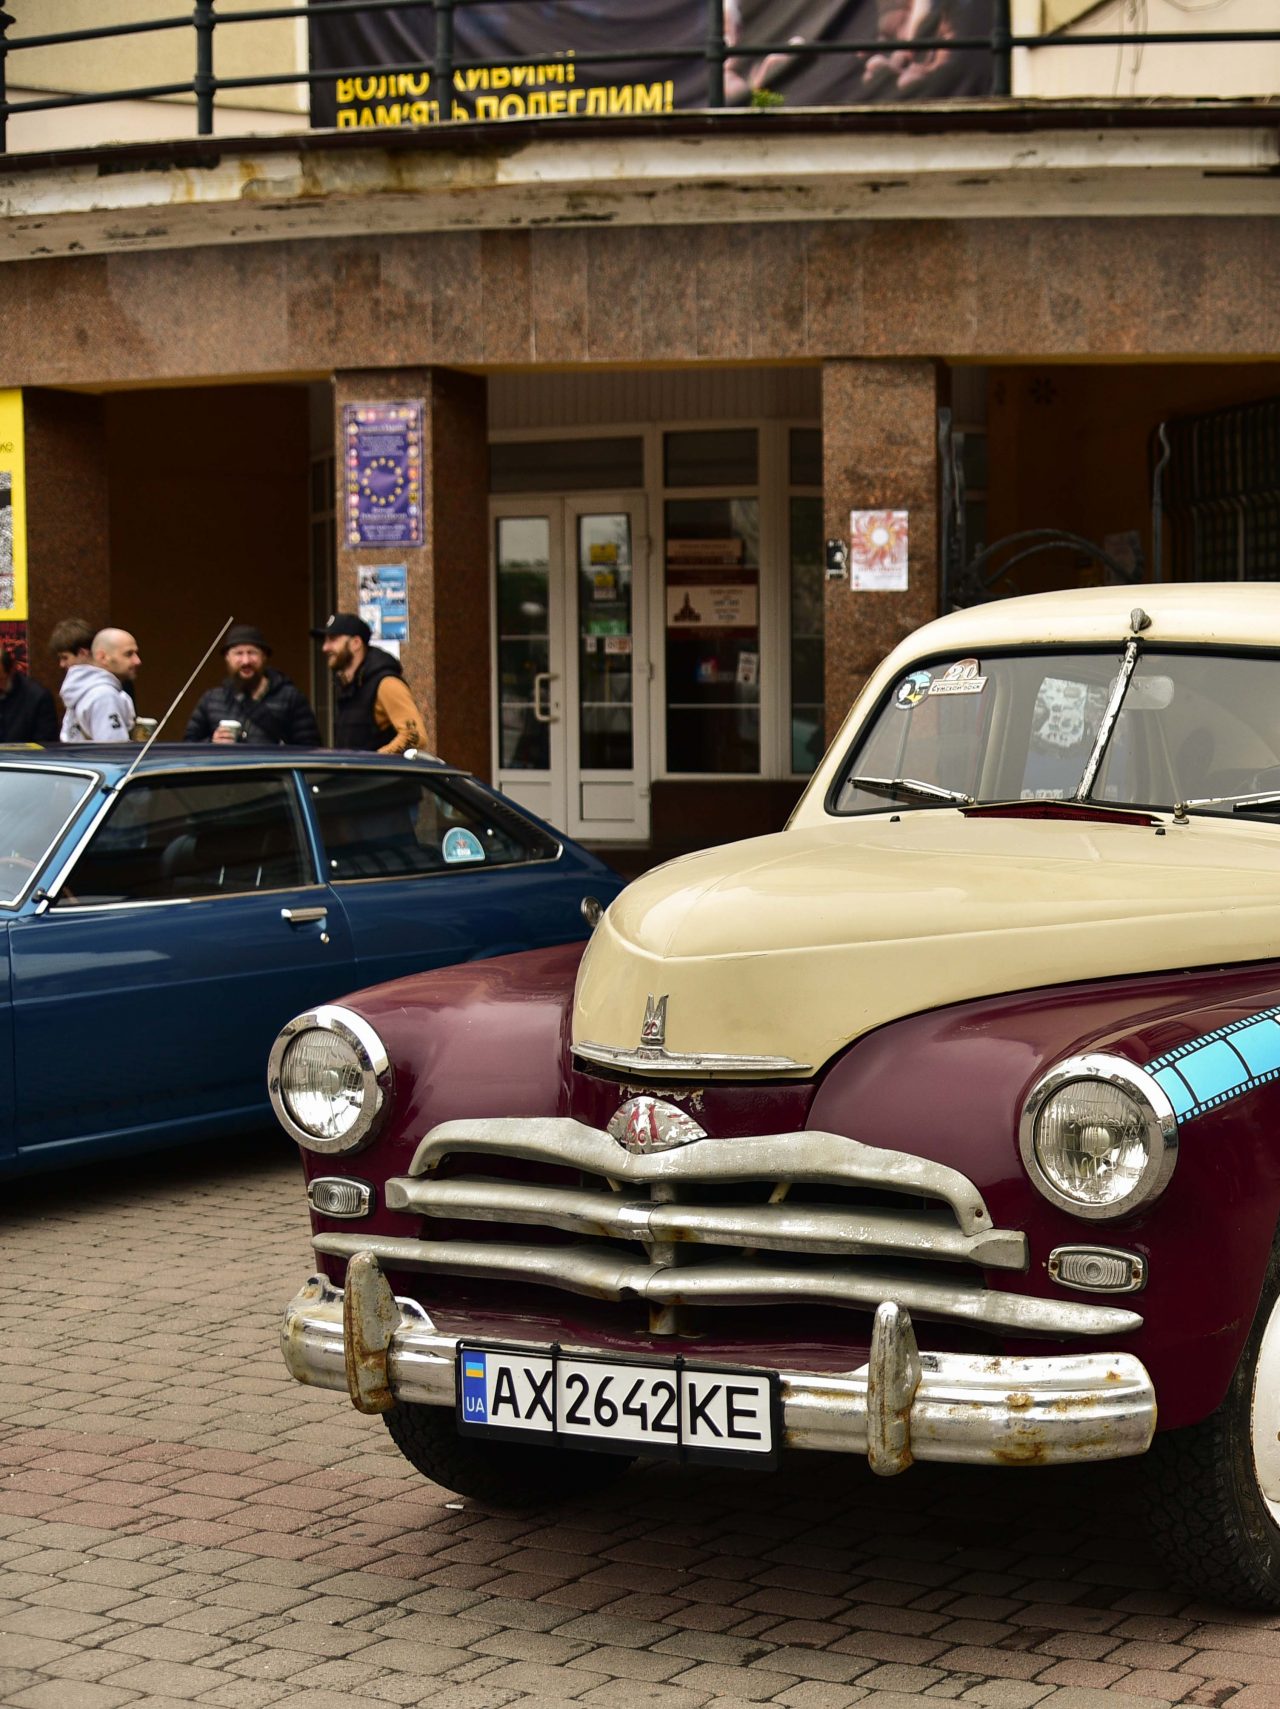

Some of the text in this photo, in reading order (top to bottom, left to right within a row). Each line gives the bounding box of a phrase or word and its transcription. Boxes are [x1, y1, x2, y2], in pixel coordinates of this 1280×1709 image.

[466, 1398, 485, 1414] UA
[492, 1366, 761, 1440] AX 2642 KE
